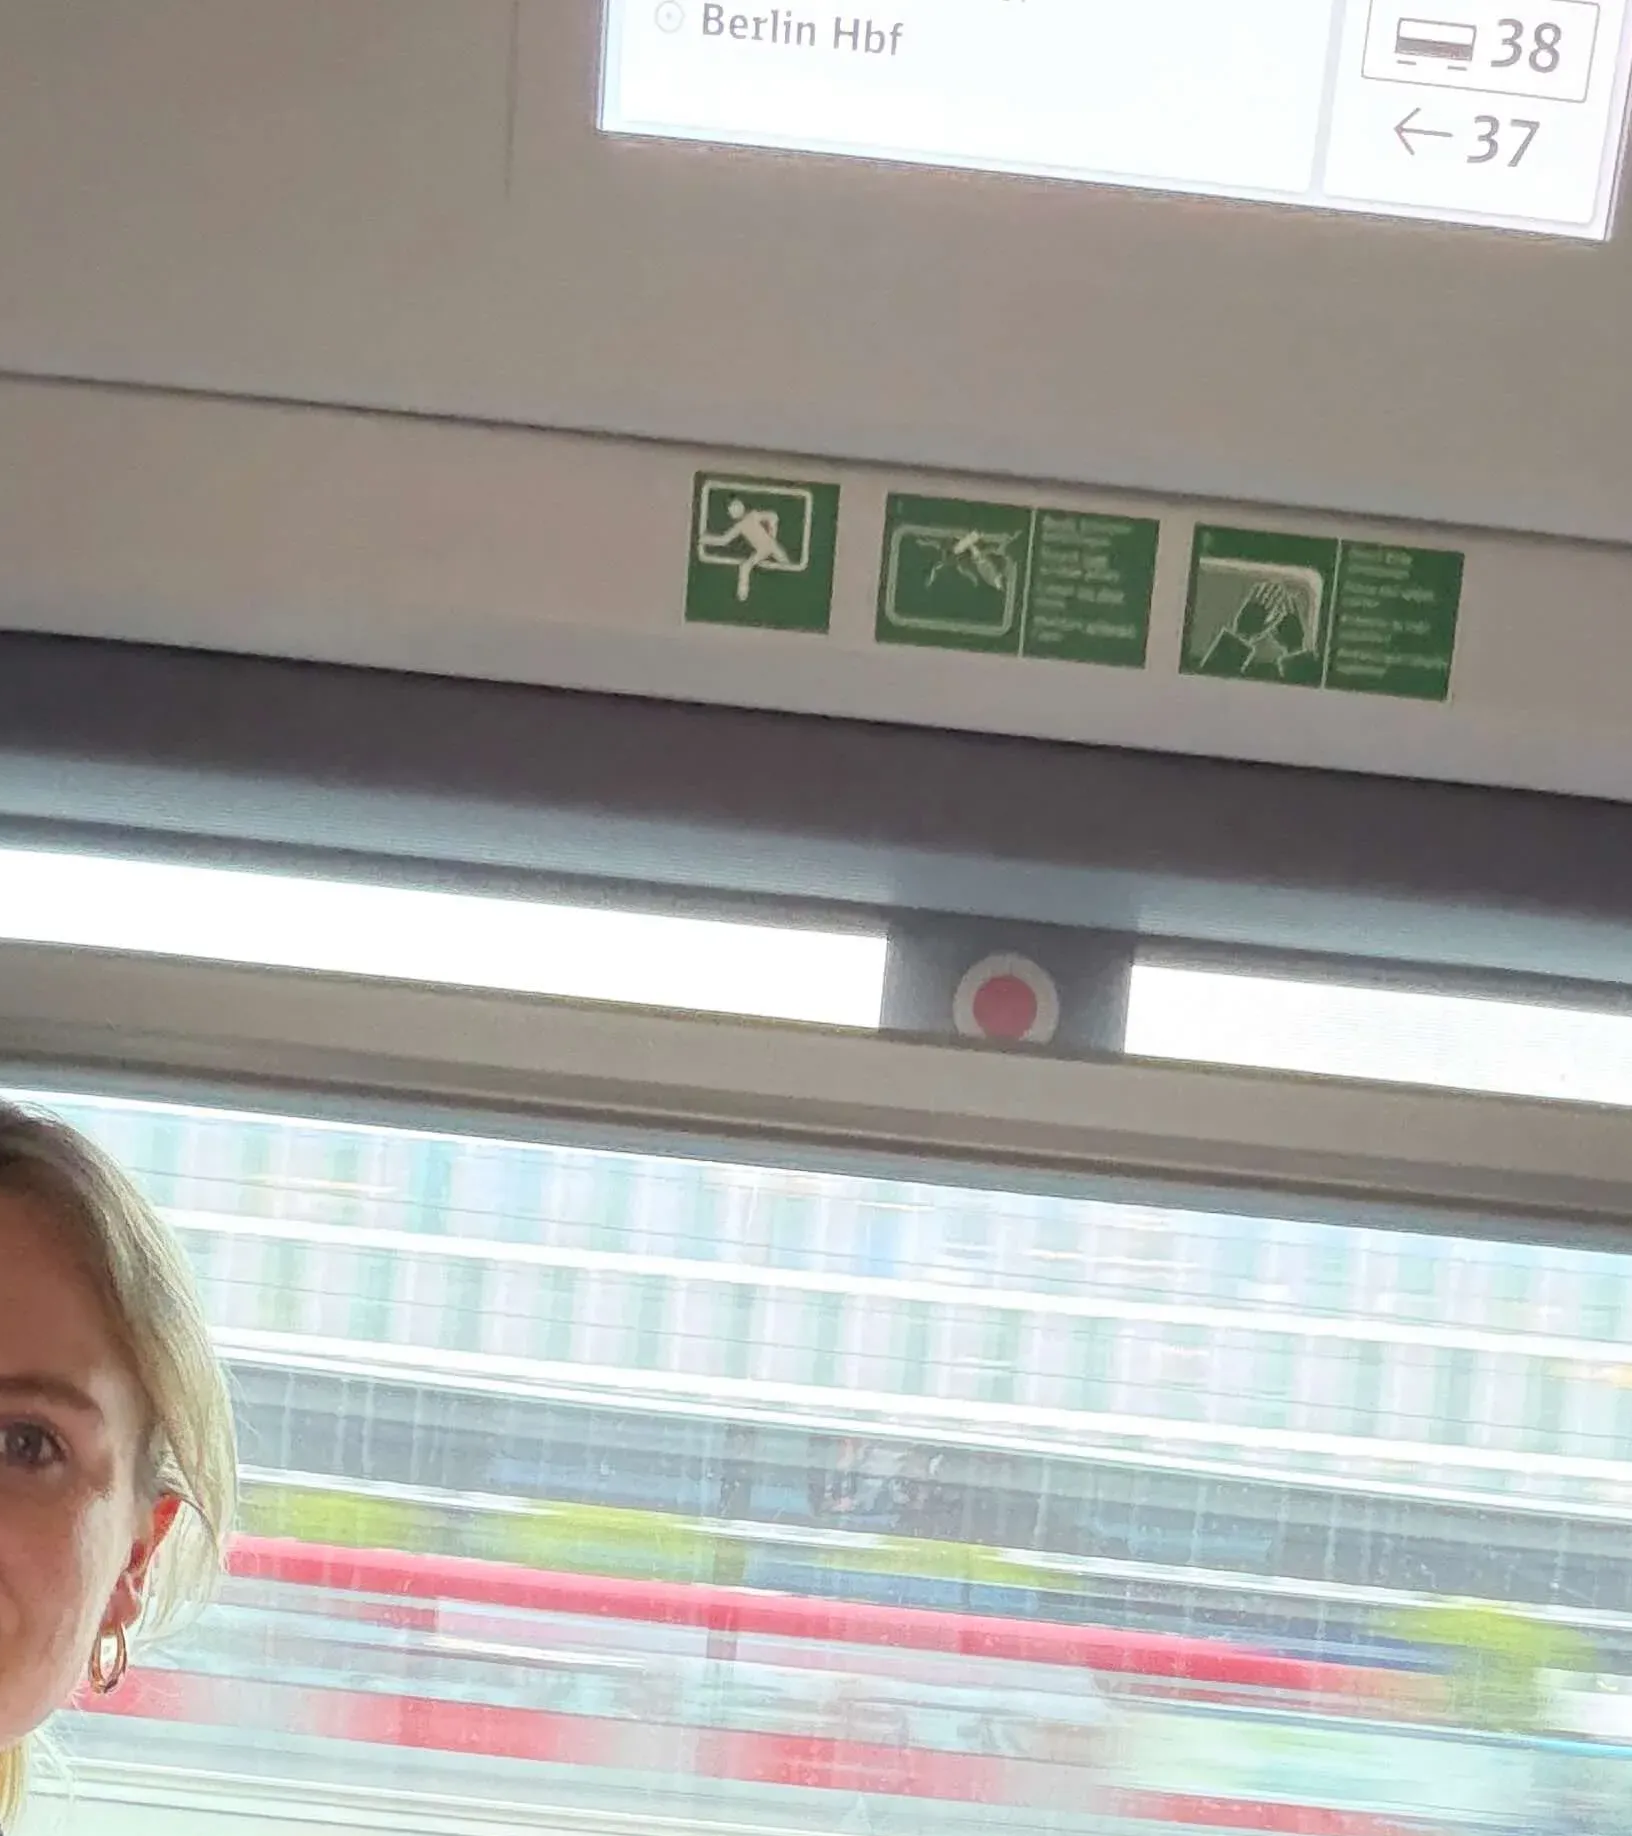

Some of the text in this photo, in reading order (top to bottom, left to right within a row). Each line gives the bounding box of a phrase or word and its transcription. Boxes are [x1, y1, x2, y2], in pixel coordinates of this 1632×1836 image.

[701, 3, 904, 57] Berlin Hbf
[1489, 17, 1563, 74] 38
[1466, 114, 1540, 168] 37
